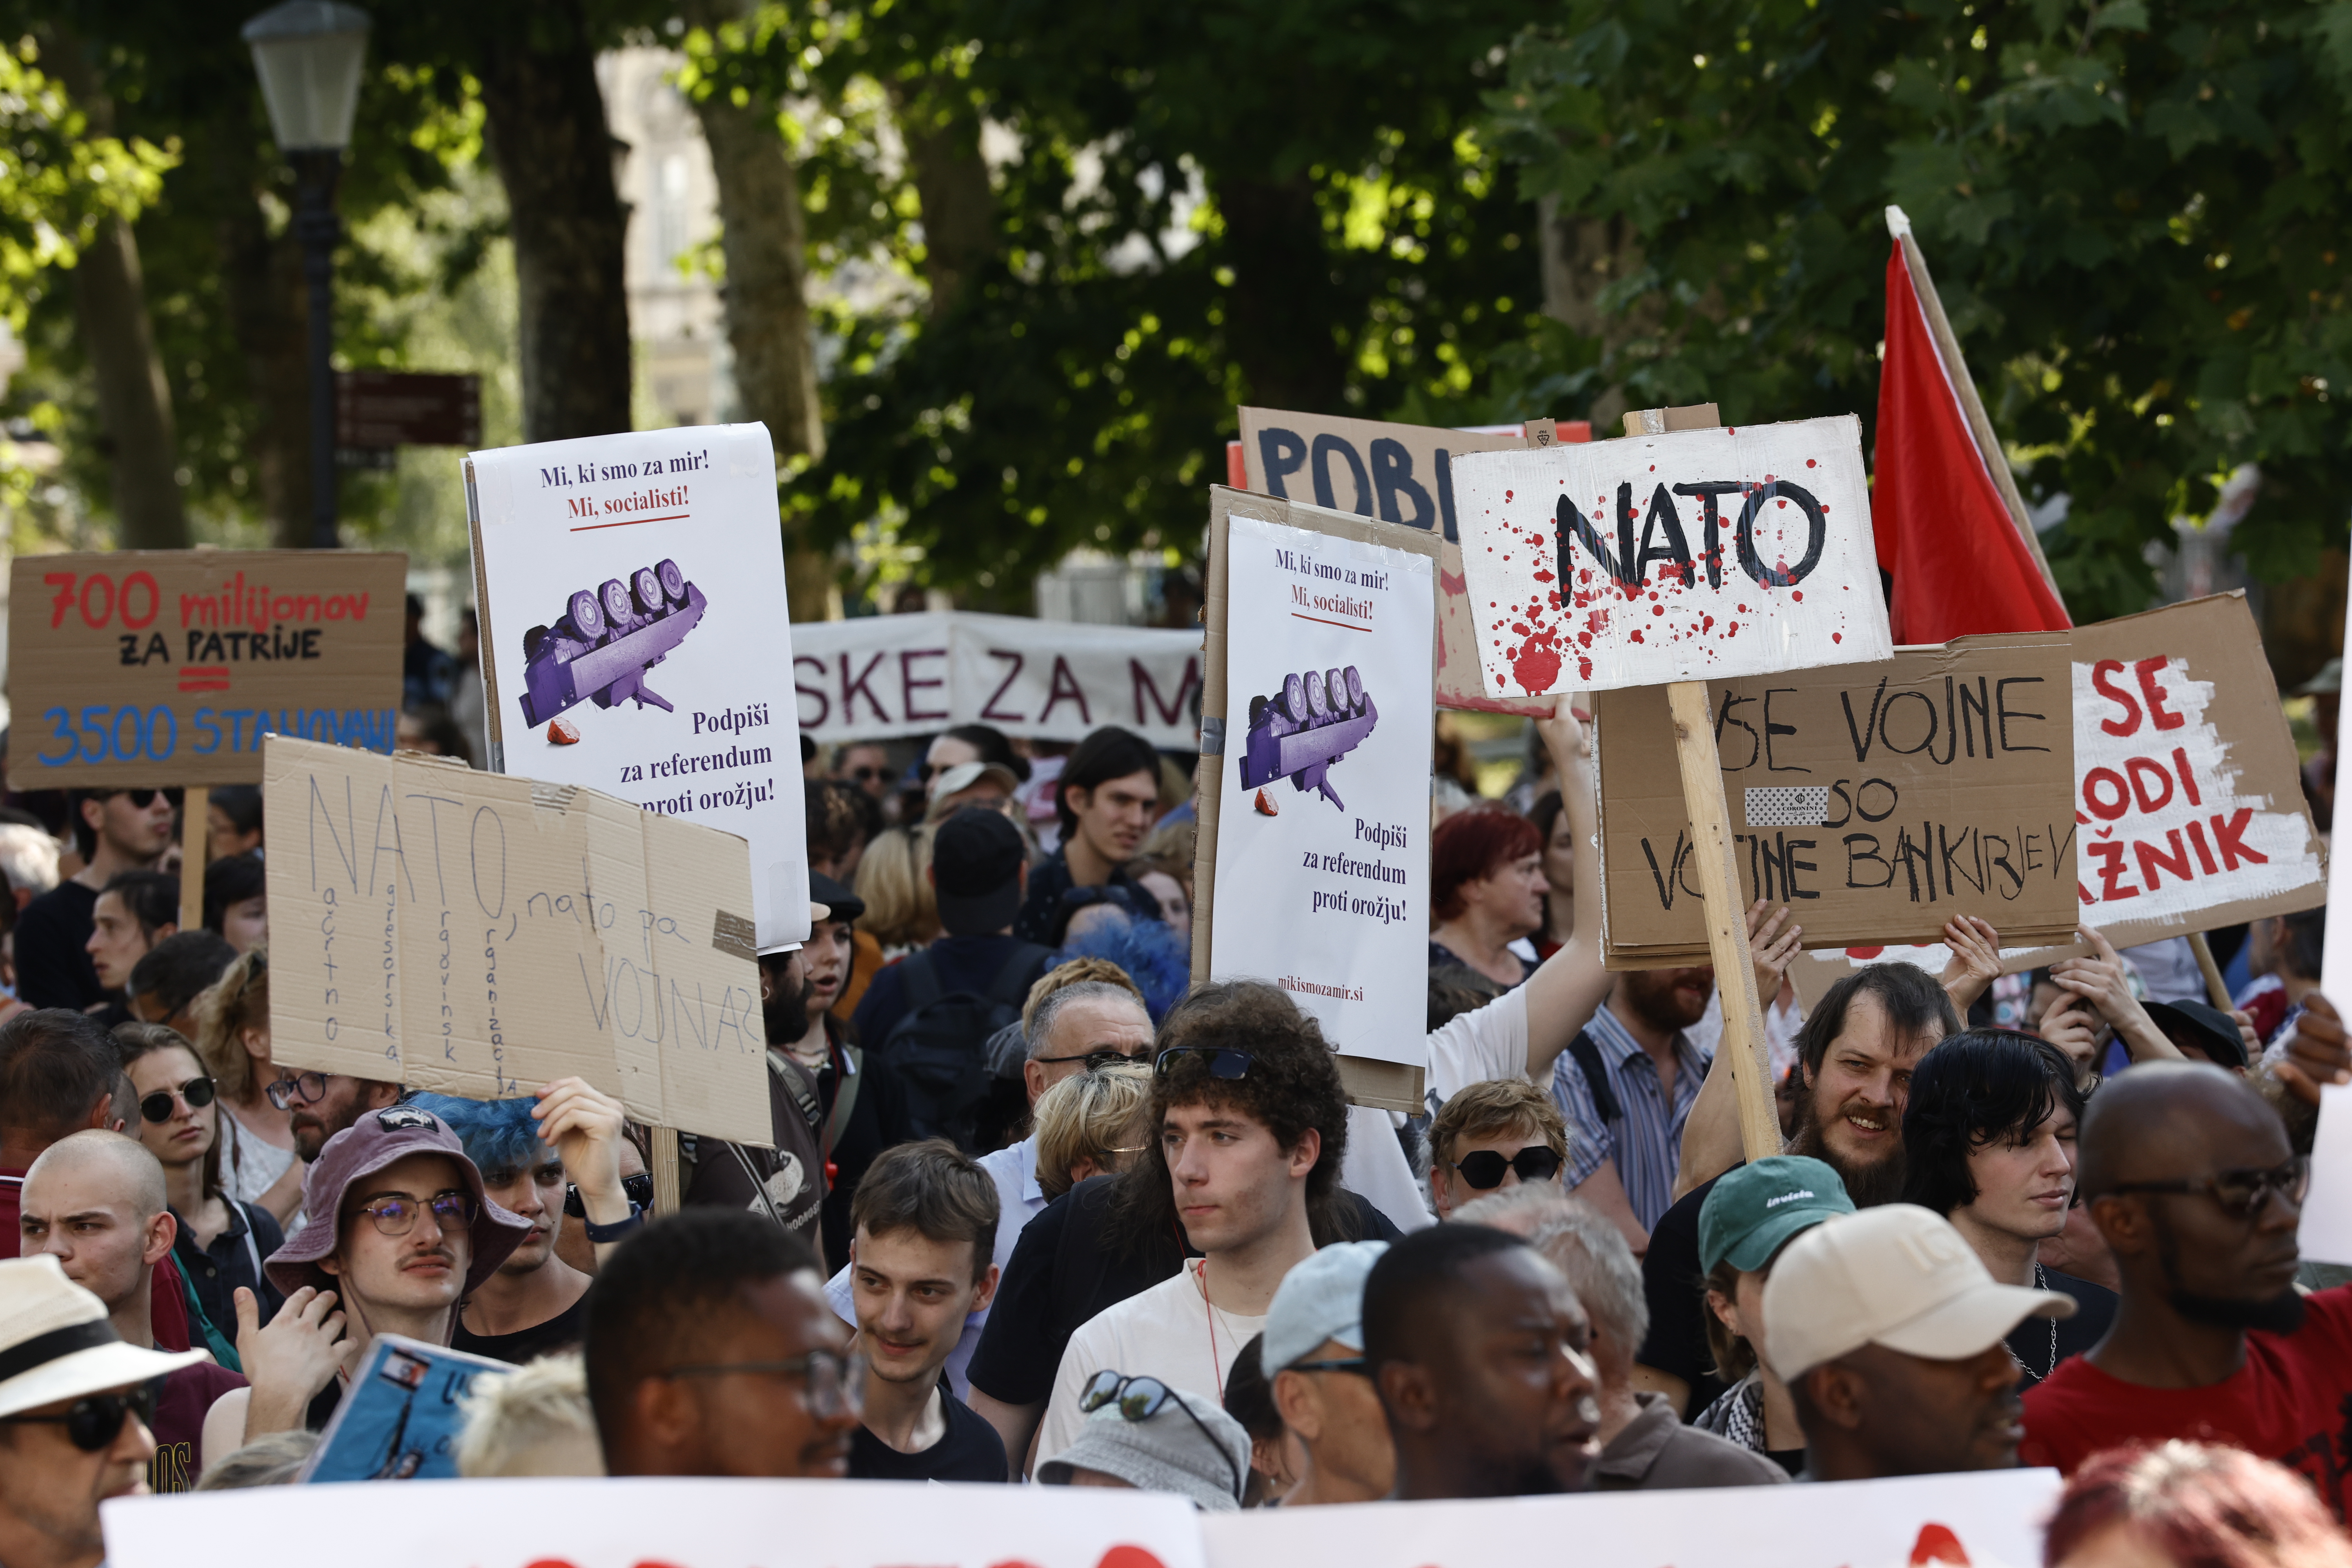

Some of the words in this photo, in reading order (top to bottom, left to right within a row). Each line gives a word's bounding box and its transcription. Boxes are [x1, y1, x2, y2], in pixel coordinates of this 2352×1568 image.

[539, 466, 573, 489] Mi,
[579, 463, 596, 484] ki
[601, 463, 638, 483] smo
[643, 460, 664, 476] za
[669, 449, 710, 473] mir!
[567, 496, 599, 519] Mi,
[604, 485, 690, 514] socialisti!
[1555, 480, 1826, 609] NATO
[1275, 548, 1297, 576] Mi,
[1300, 554, 1311, 575] ki
[1314, 562, 1341, 581] smo
[1345, 568, 1357, 585] za
[1361, 570, 1388, 592] mir!
[44, 570, 160, 630] 700
[179, 570, 370, 634] milijonov
[1291, 584, 1310, 611] Mi,
[1314, 594, 1373, 620] socialisti!
[119, 633, 170, 666] ZA
[979, 649, 1091, 725] ZA
[2092, 654, 2185, 737] SE
[37, 705, 177, 767] 3500
[691, 703, 770, 735] Podpiši
[1841, 676, 2051, 764] VOJNE
[621, 764, 643, 783] za
[650, 745, 772, 779] referendum
[642, 789, 693, 815] proti
[699, 778, 775, 810] orožju!
[1822, 778, 1897, 828] SO
[2076, 747, 2201, 824] ODI
[1354, 818, 1407, 851] Podpiši
[1303, 851, 1318, 867] za
[1322, 852, 1406, 885] referendum
[1312, 889, 1347, 913] proti
[1352, 895, 1406, 925] orožju!
[638, 910, 691, 964] pa
[578, 953, 759, 1054] VOJNA?
[1278, 975, 1363, 1002] mikismozamir.si
